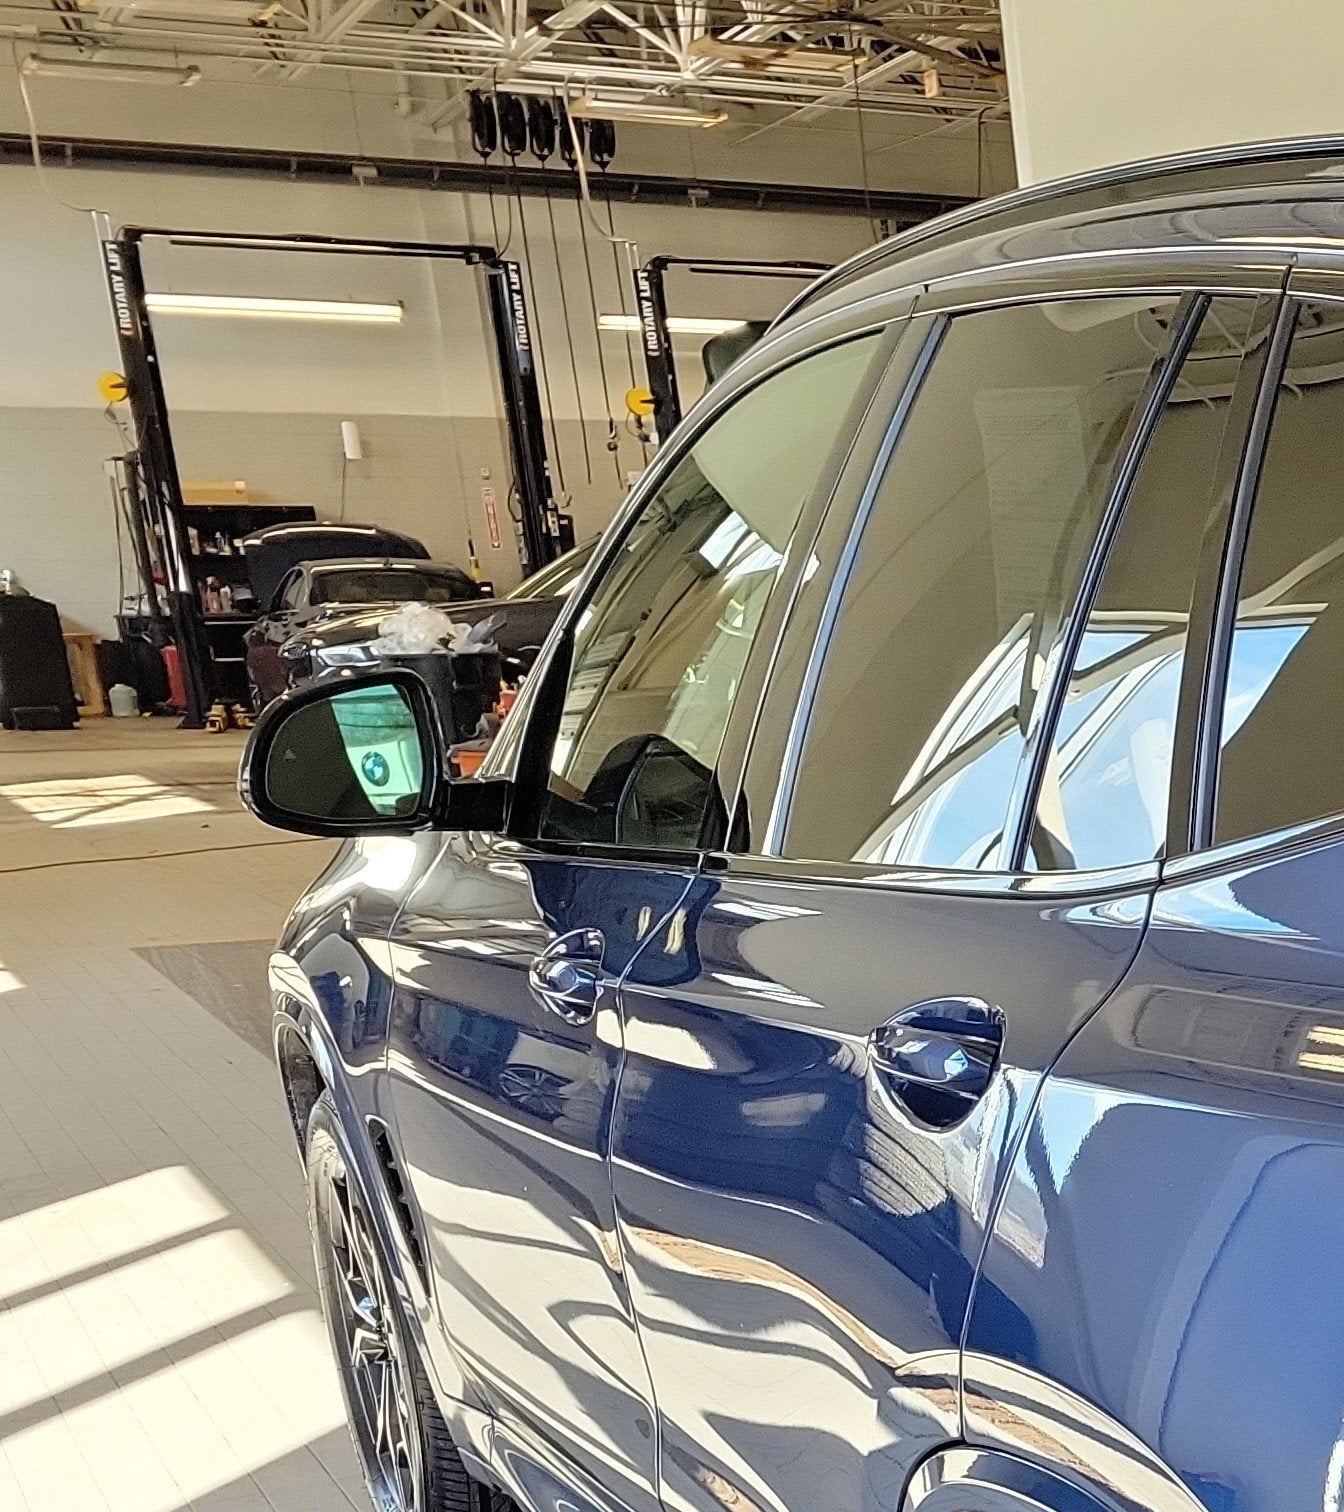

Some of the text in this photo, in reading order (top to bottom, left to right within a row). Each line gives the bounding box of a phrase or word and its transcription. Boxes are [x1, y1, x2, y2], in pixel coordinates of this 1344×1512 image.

[105, 242, 133, 328] ROTARY LIFT
[507, 262, 529, 345] ROTARY LIFT
[637, 270, 659, 350] ROTARY LIFT
